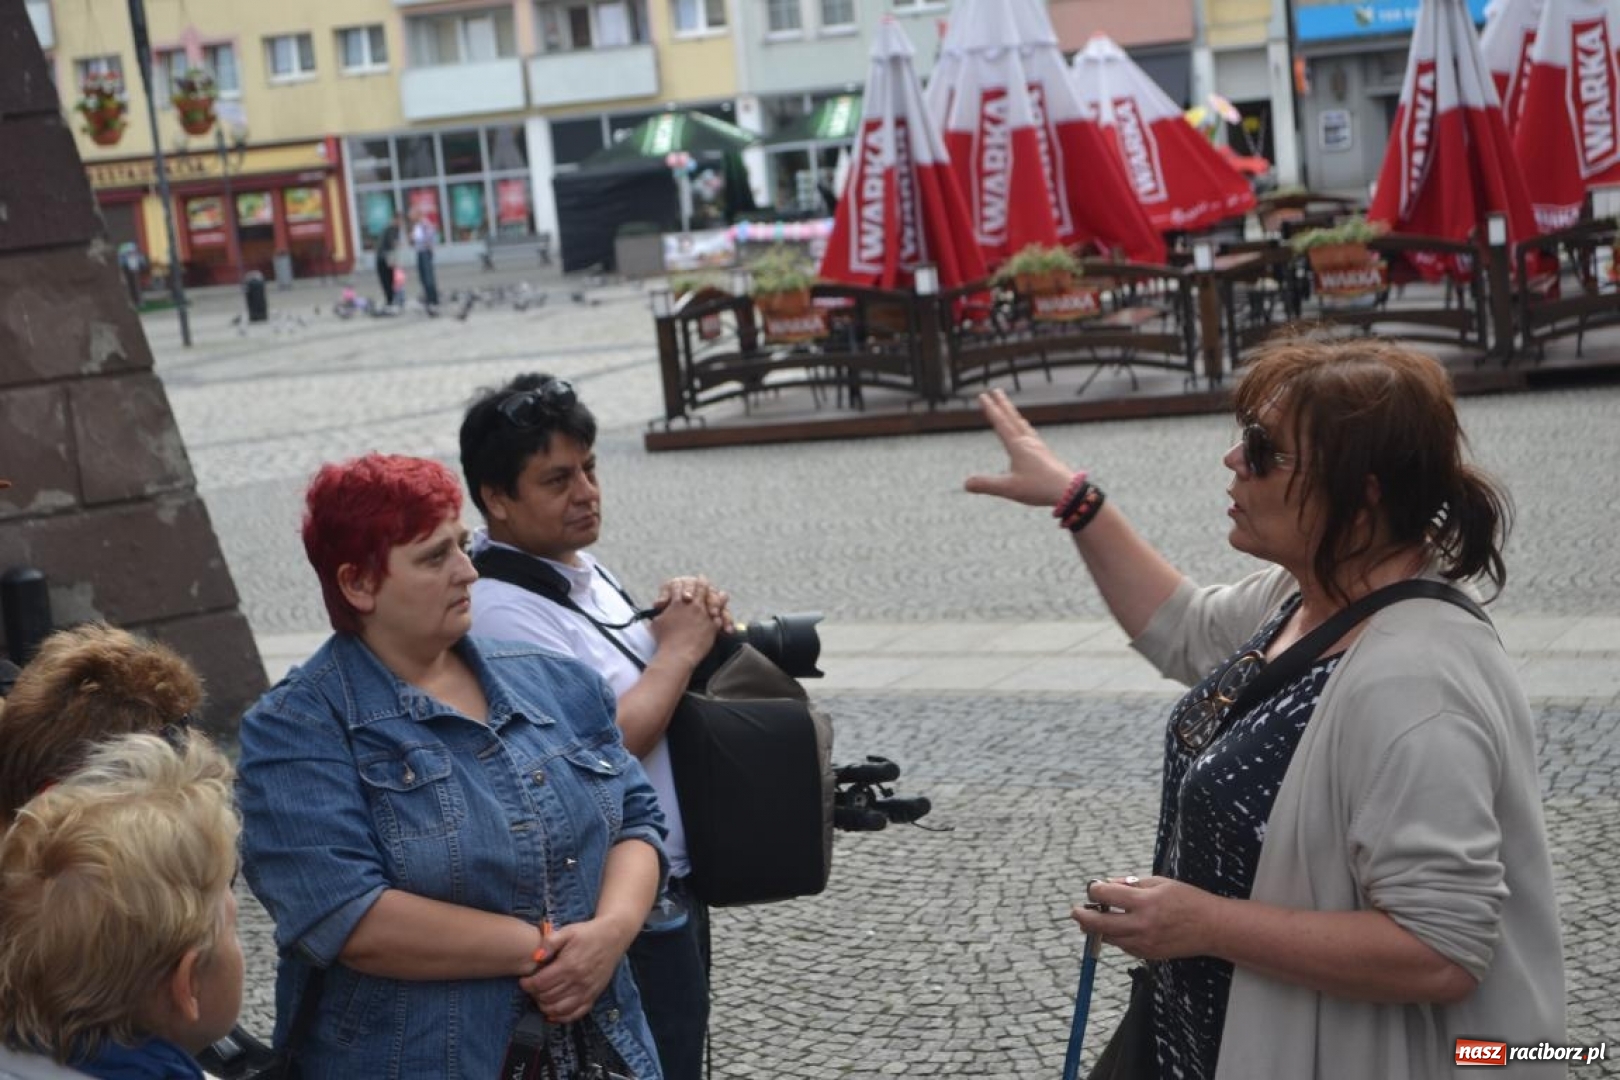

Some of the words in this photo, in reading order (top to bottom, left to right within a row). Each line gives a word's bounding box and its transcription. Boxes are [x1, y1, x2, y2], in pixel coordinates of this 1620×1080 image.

[1576, 25, 1613, 164] WARKA
[861, 128, 885, 262] WARKA
[982, 95, 1009, 233] WARKA
[1320, 268, 1381, 288] WARKA
